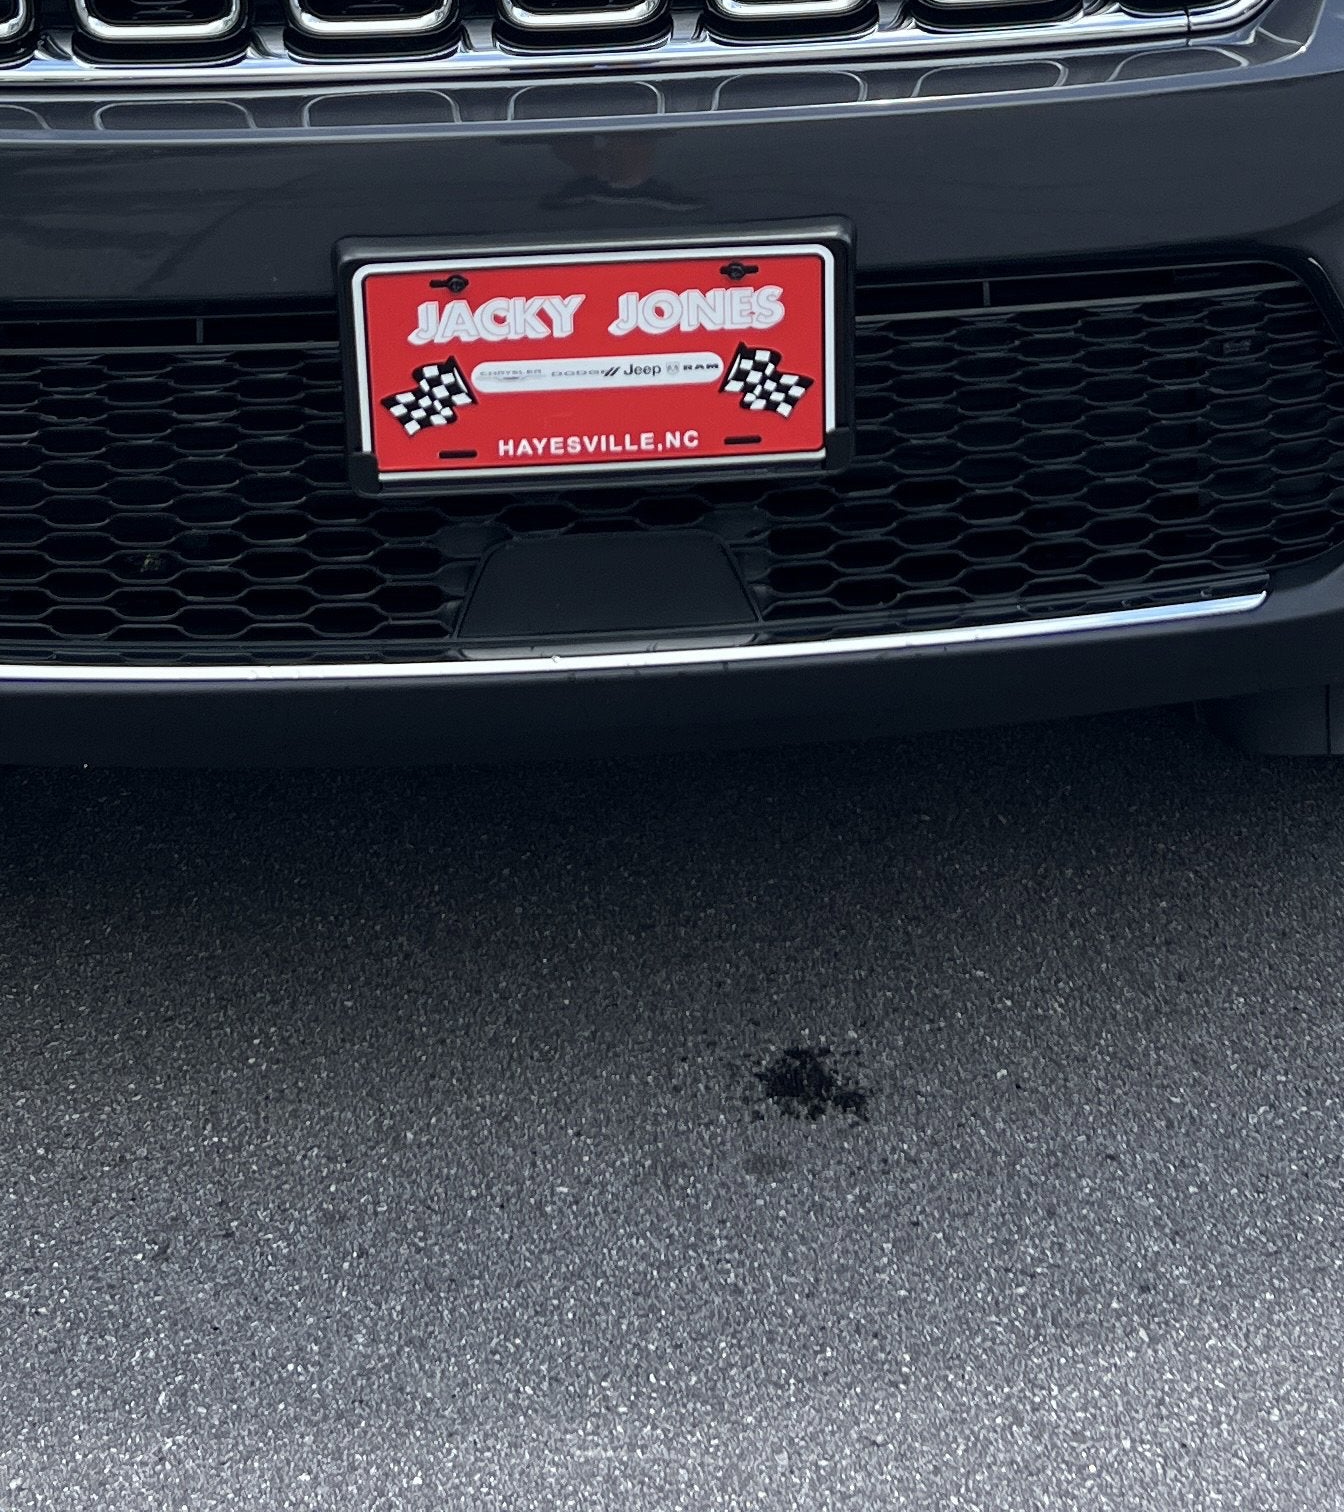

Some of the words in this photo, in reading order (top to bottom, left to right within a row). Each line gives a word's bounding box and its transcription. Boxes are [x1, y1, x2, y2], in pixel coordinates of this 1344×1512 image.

[407, 293, 587, 346] JACKY
[607, 285, 786, 337] JONES
[622, 363, 662, 377] Jeep
[683, 362, 719, 371] RAM
